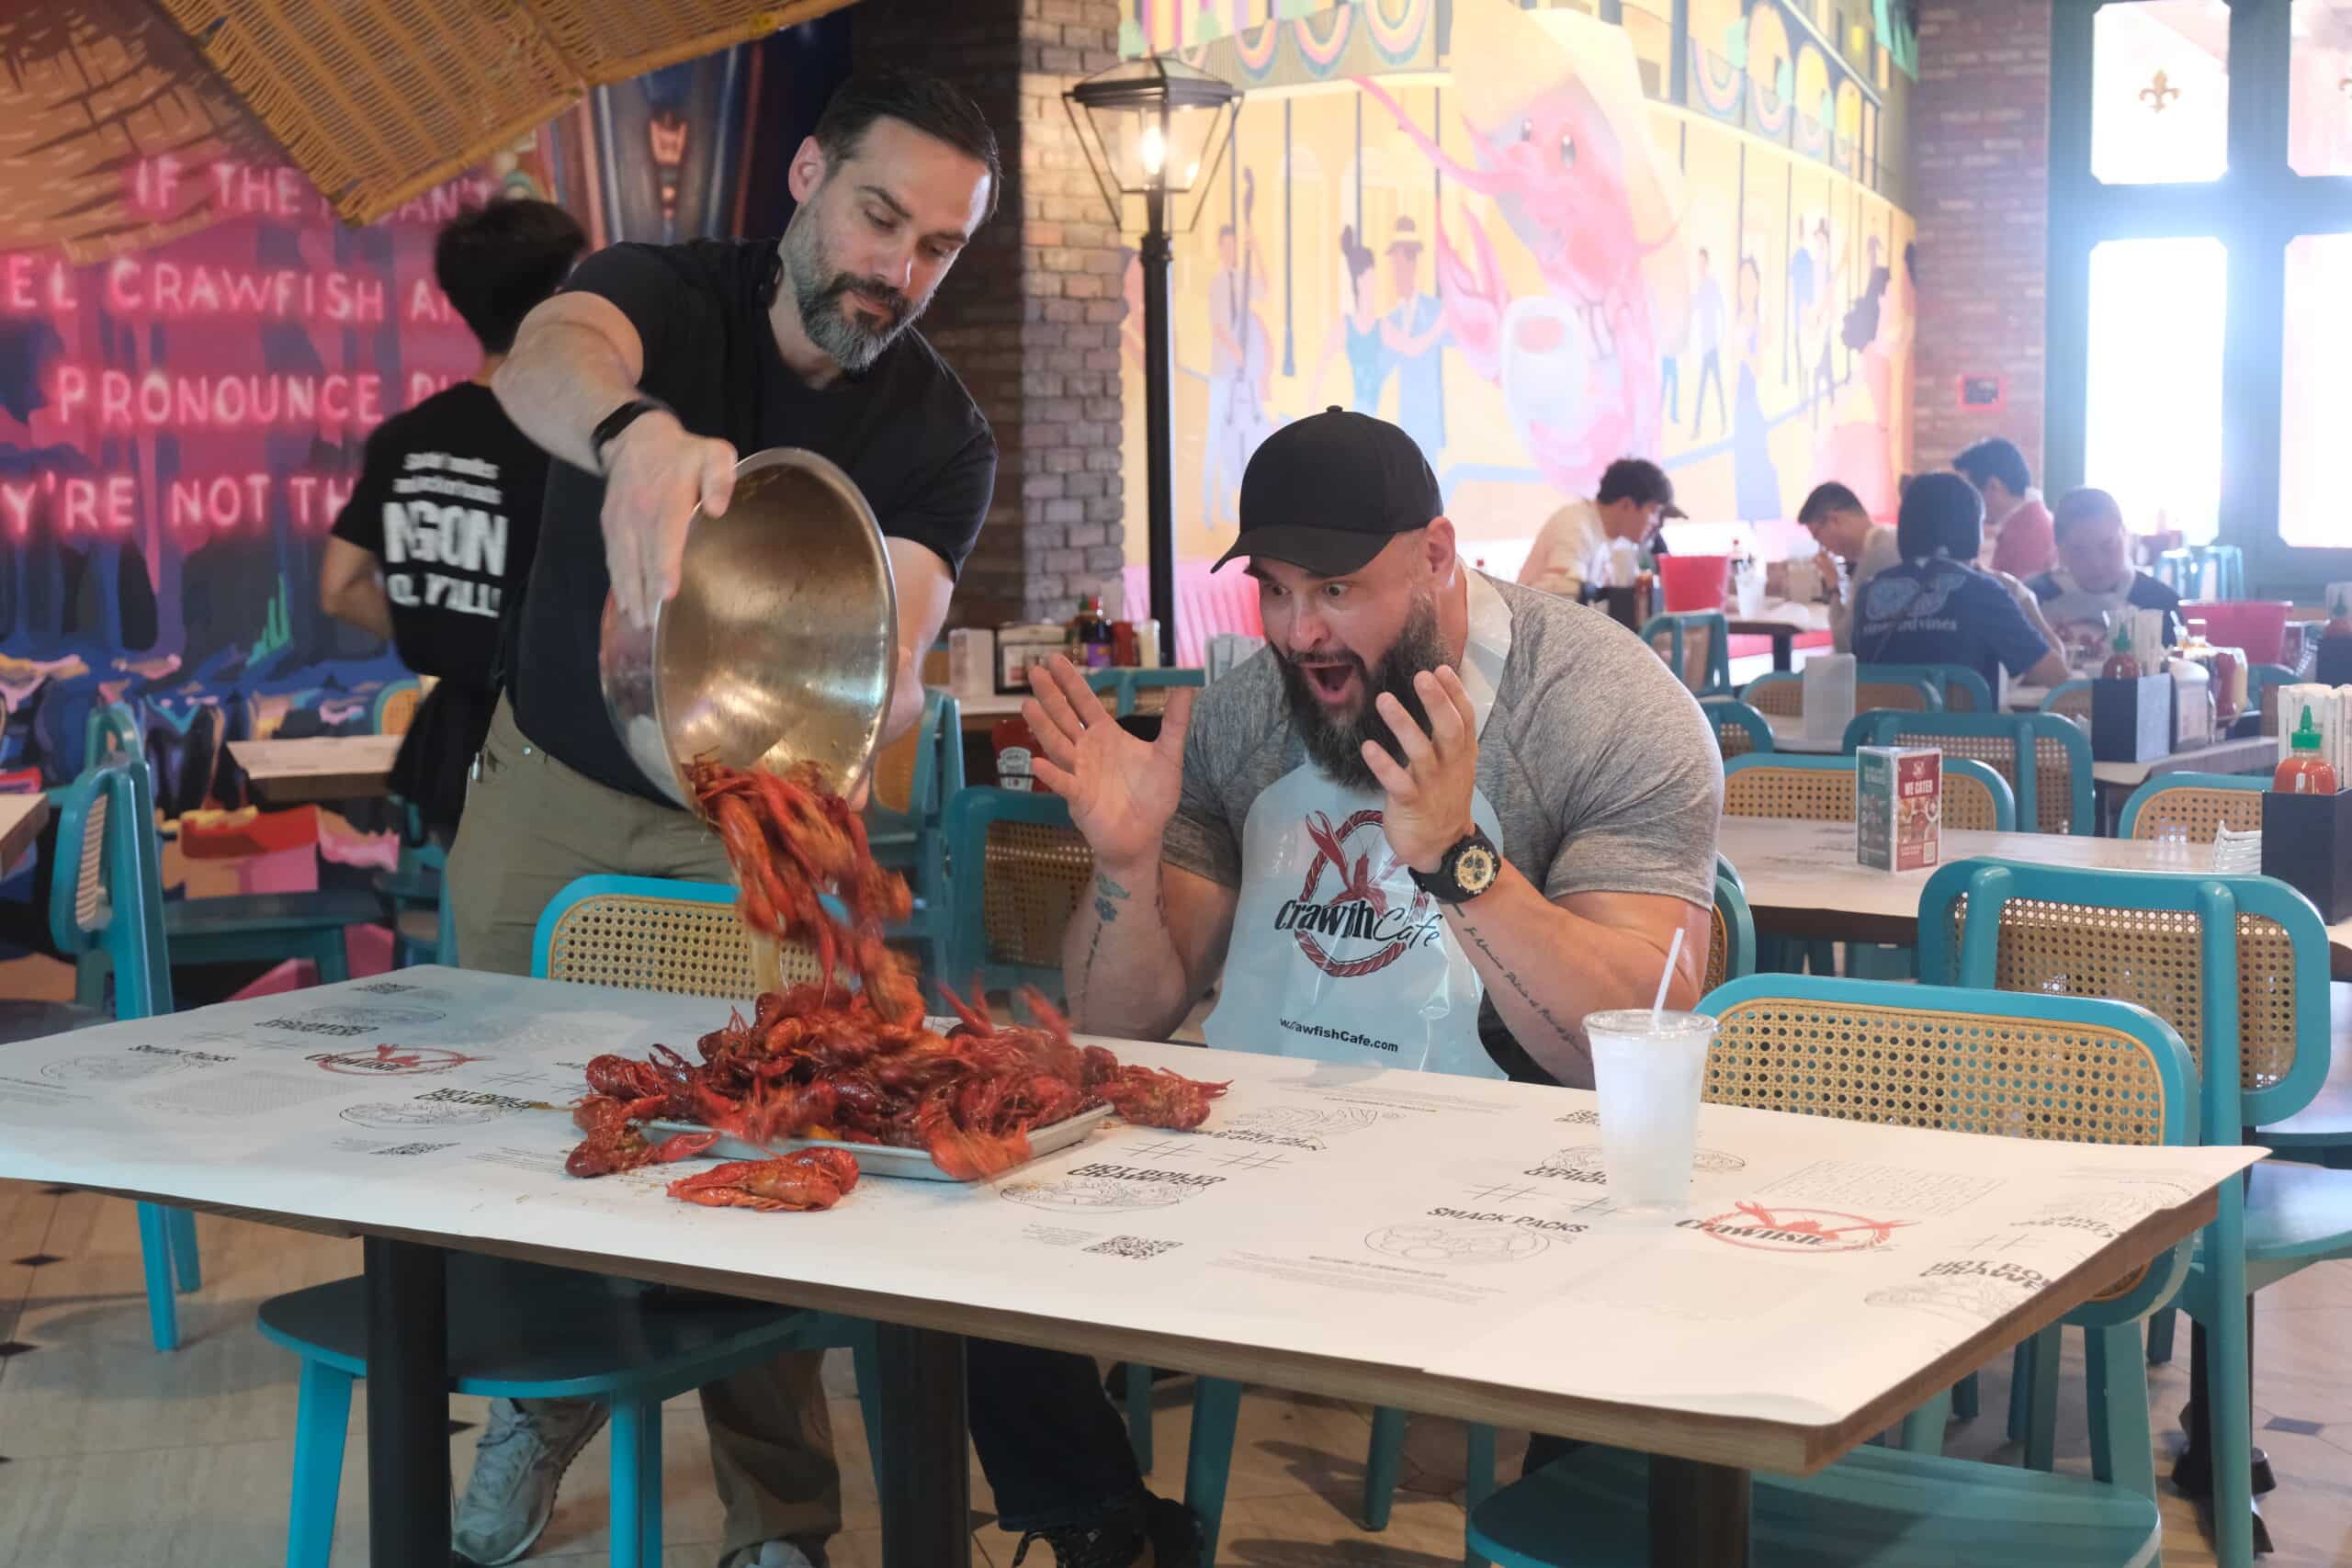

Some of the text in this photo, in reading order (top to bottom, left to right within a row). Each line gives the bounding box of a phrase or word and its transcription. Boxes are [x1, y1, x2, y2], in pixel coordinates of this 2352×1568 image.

[135, 156, 181, 209] IF
[379, 177, 496, 225] AN'T
[111, 258, 385, 321] CRAWFISH
[57, 367, 383, 424] PRONOUNCE
[171, 474, 271, 527] NOT
[1373, 907, 1443, 950] Cafe
[1427, 1207, 1589, 1232] SMACK PACKS
